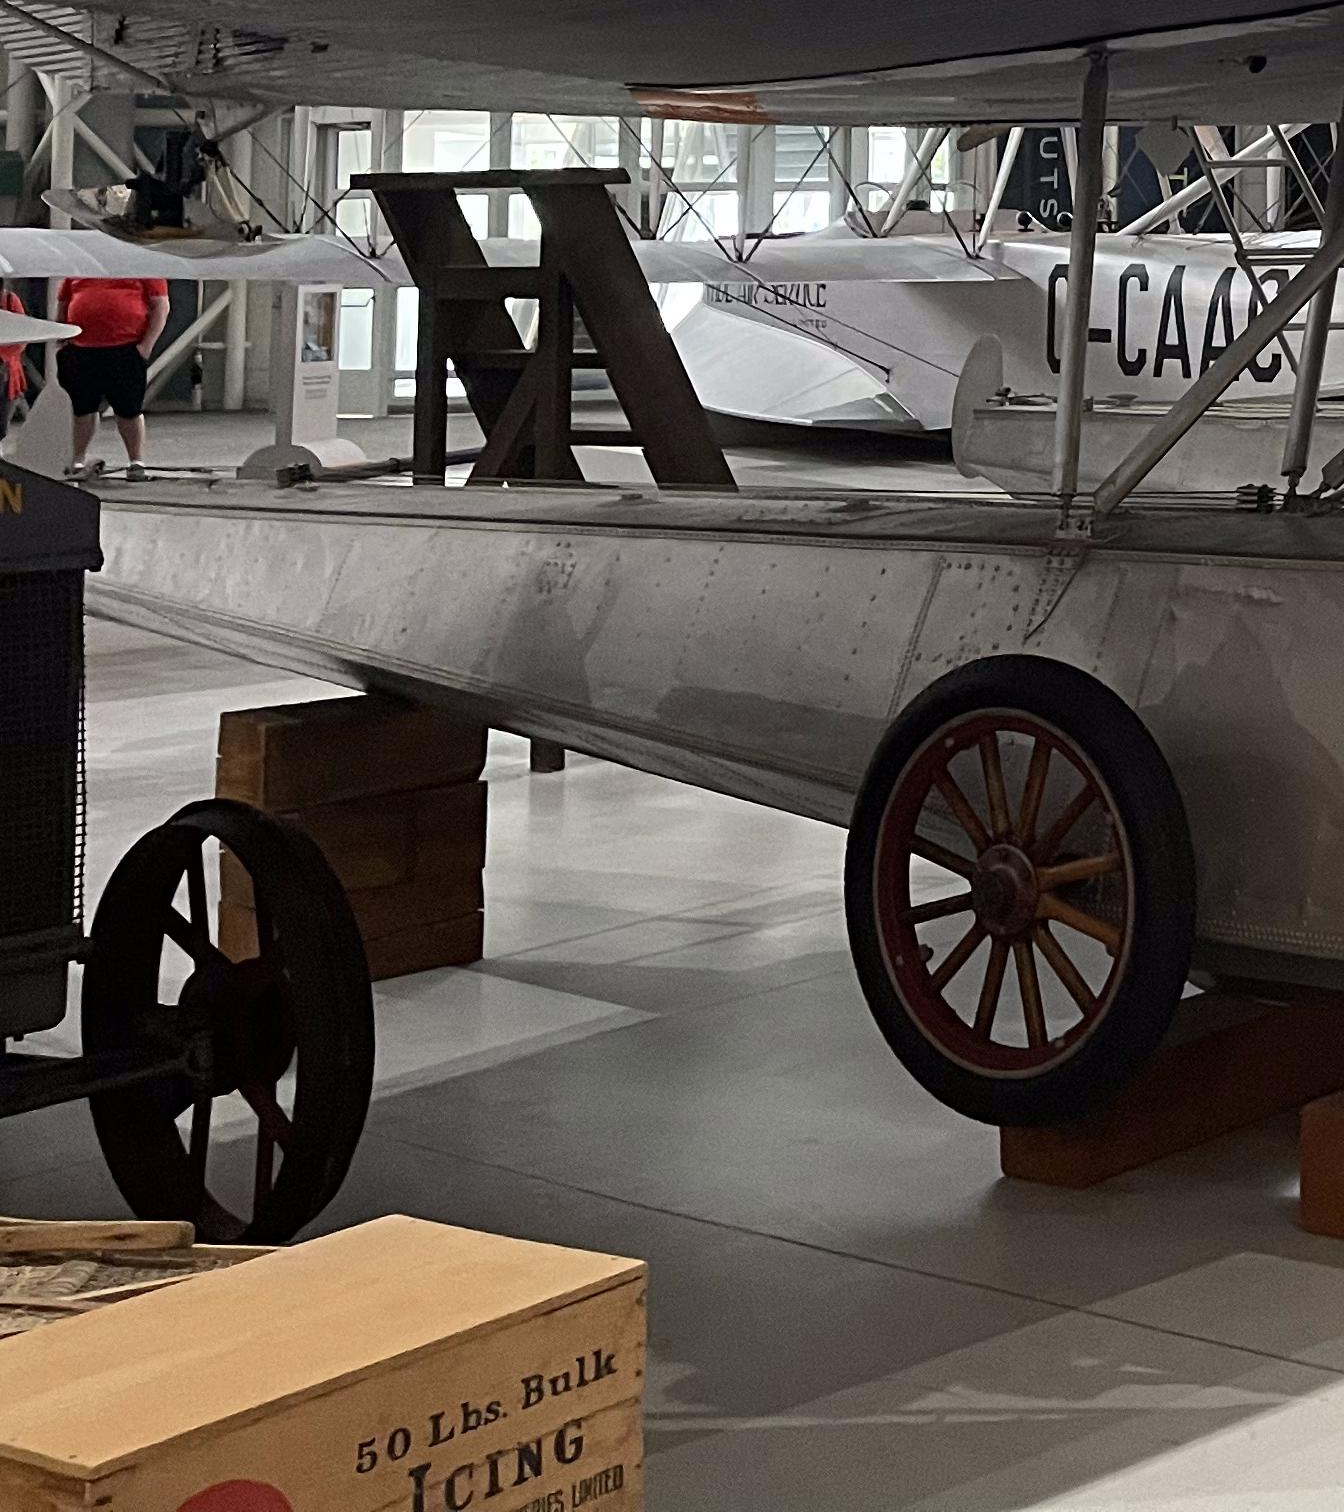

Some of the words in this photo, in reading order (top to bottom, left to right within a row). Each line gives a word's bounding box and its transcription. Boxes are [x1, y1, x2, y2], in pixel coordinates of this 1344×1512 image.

[355, 1426, 412, 1474] 50
[428, 1399, 508, 1448] Lbs.
[520, 1348, 619, 1410] Bulk
[407, 1419, 585, 1512] ICING
